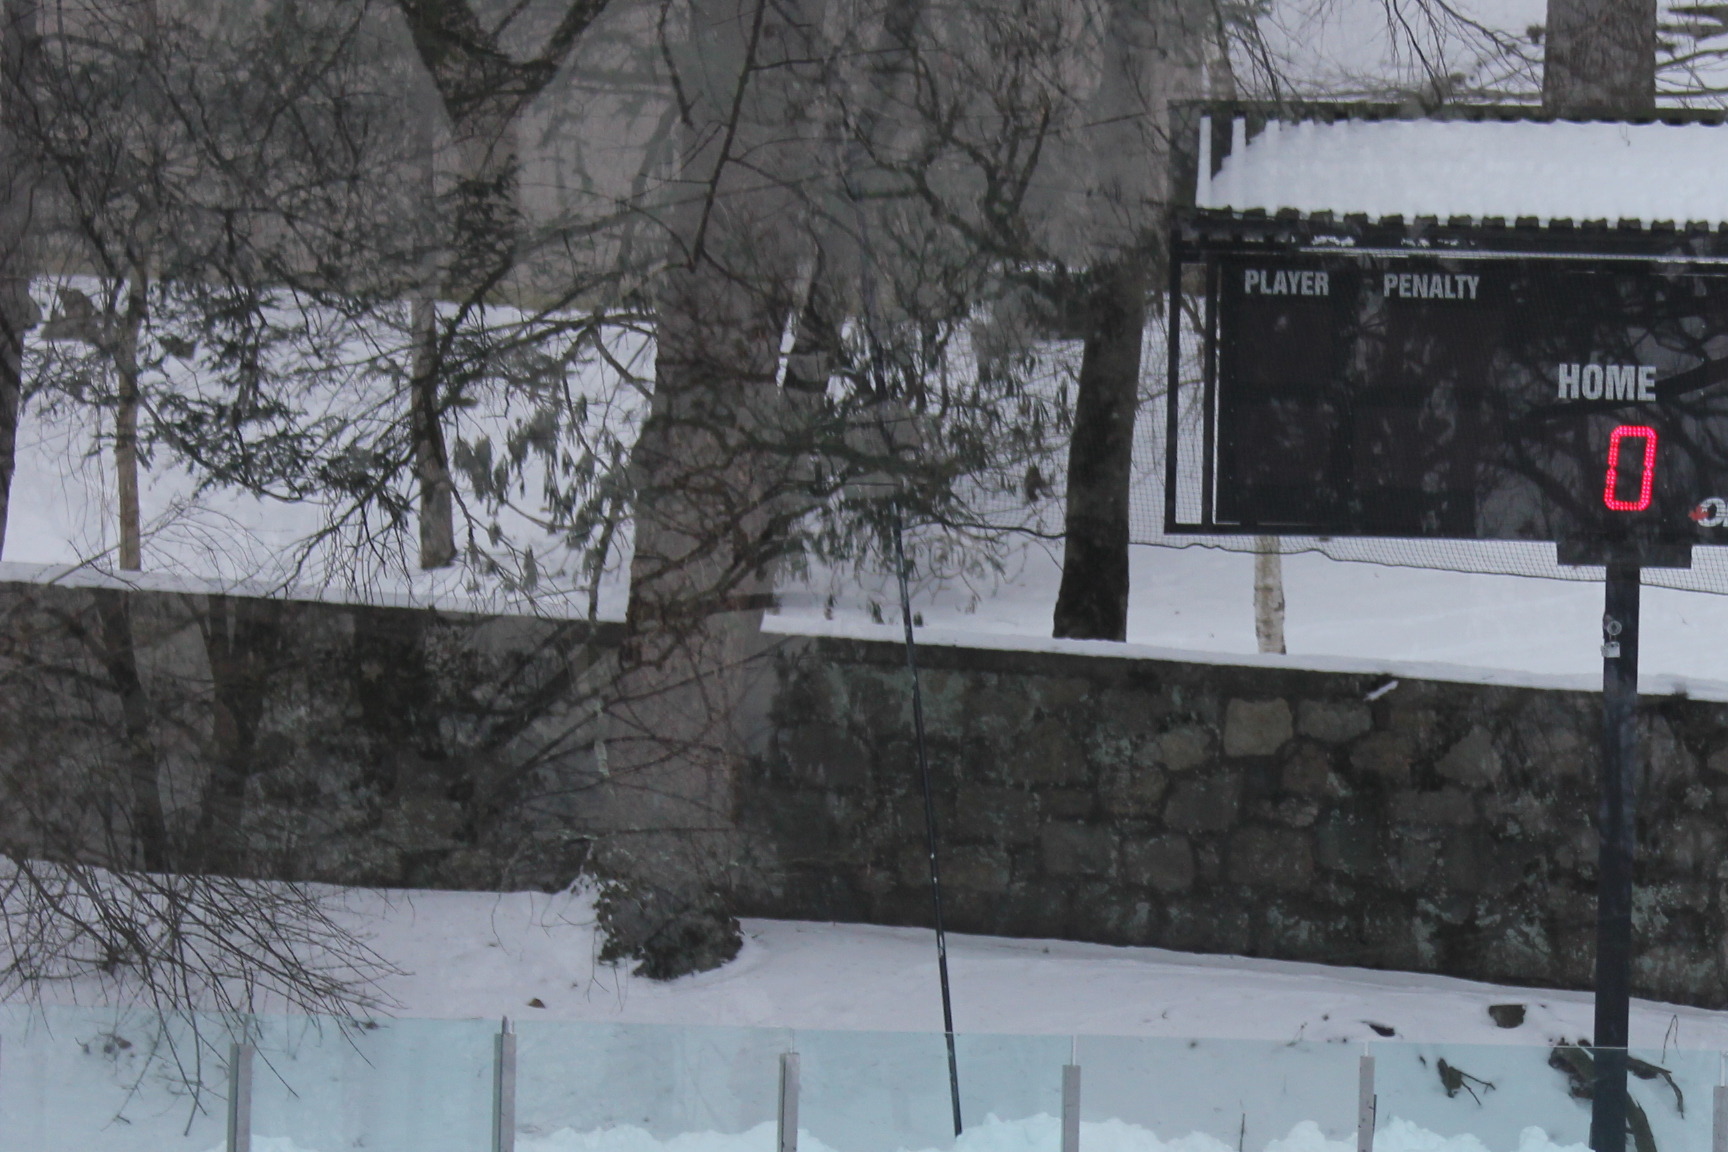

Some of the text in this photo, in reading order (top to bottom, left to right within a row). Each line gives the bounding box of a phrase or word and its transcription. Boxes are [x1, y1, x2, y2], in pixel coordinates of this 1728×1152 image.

[1244, 269, 1330, 297] PLAYER
[1383, 273, 1480, 300] PENALTY
[1558, 362, 1657, 402] HOME
[1604, 425, 1657, 511] 0
